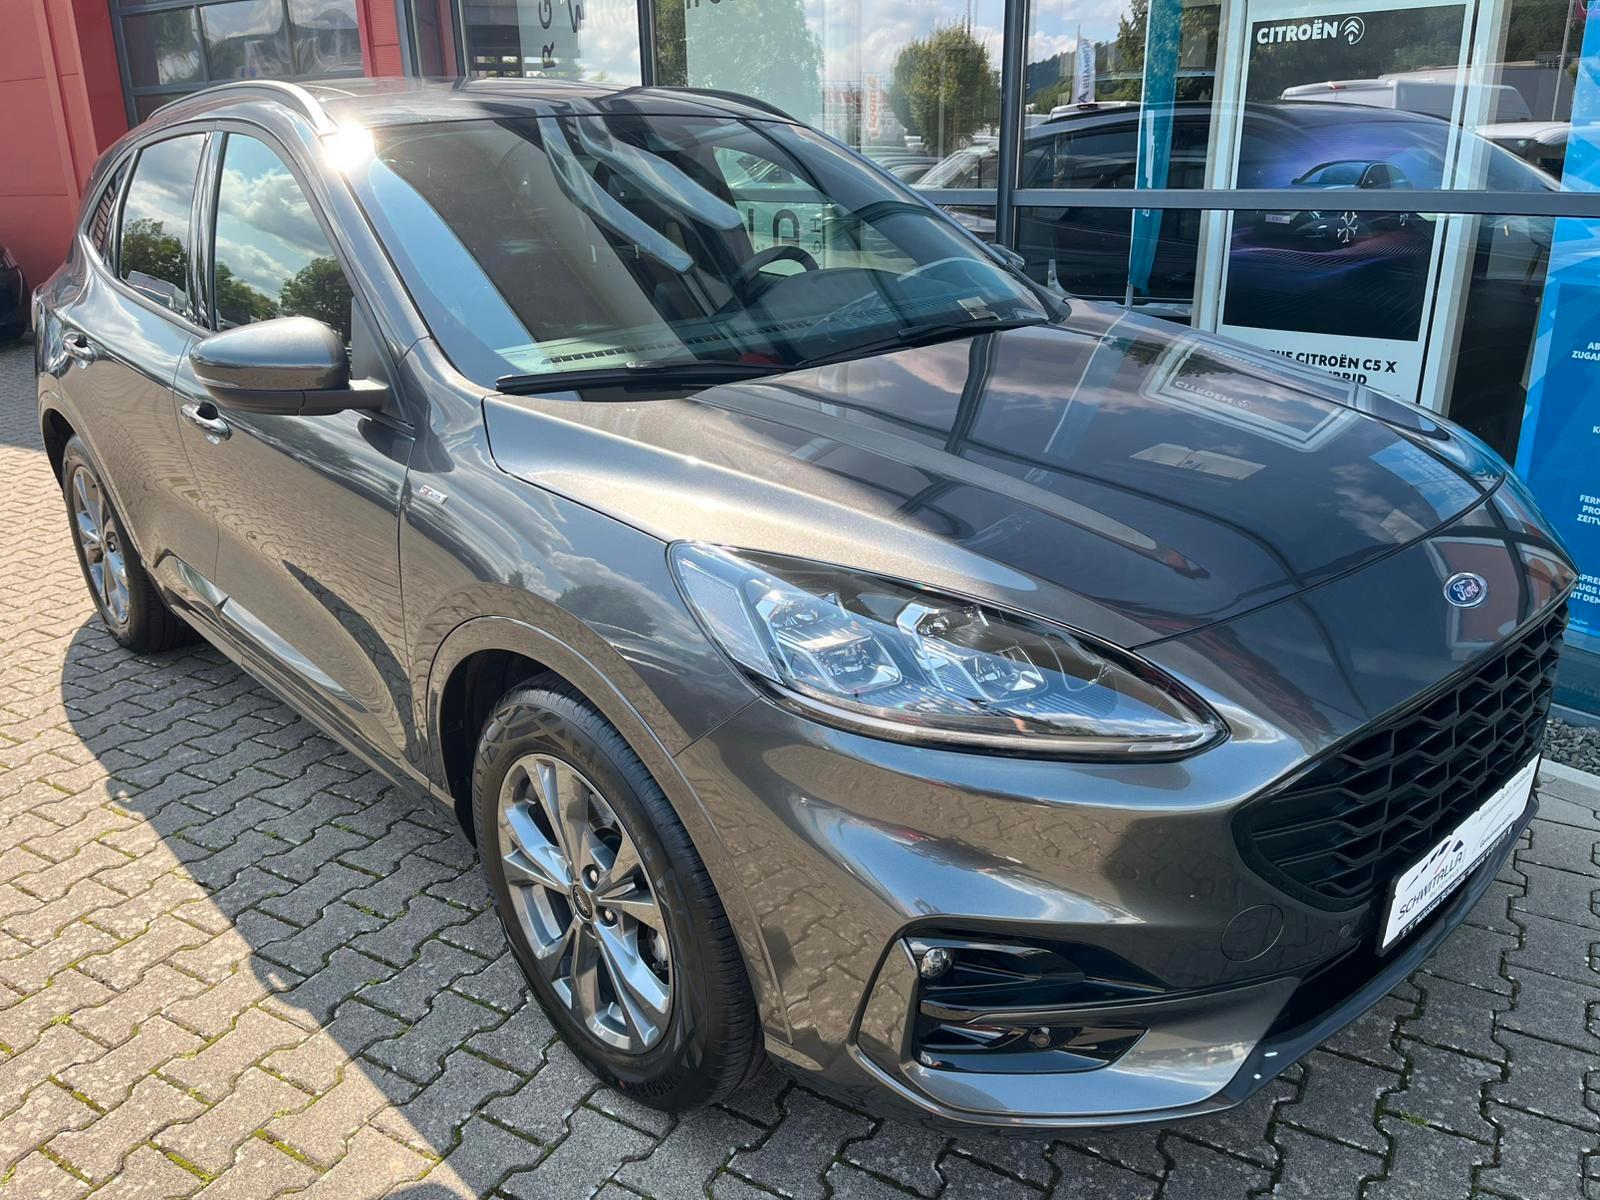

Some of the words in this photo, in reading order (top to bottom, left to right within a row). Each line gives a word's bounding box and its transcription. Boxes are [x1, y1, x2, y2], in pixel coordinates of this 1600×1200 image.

[1256, 19, 1339, 44] CITROËN
[1296, 352, 1360, 370] CITROËN
[1362, 359, 1382, 372] C5
[1385, 361, 1397, 373] X
